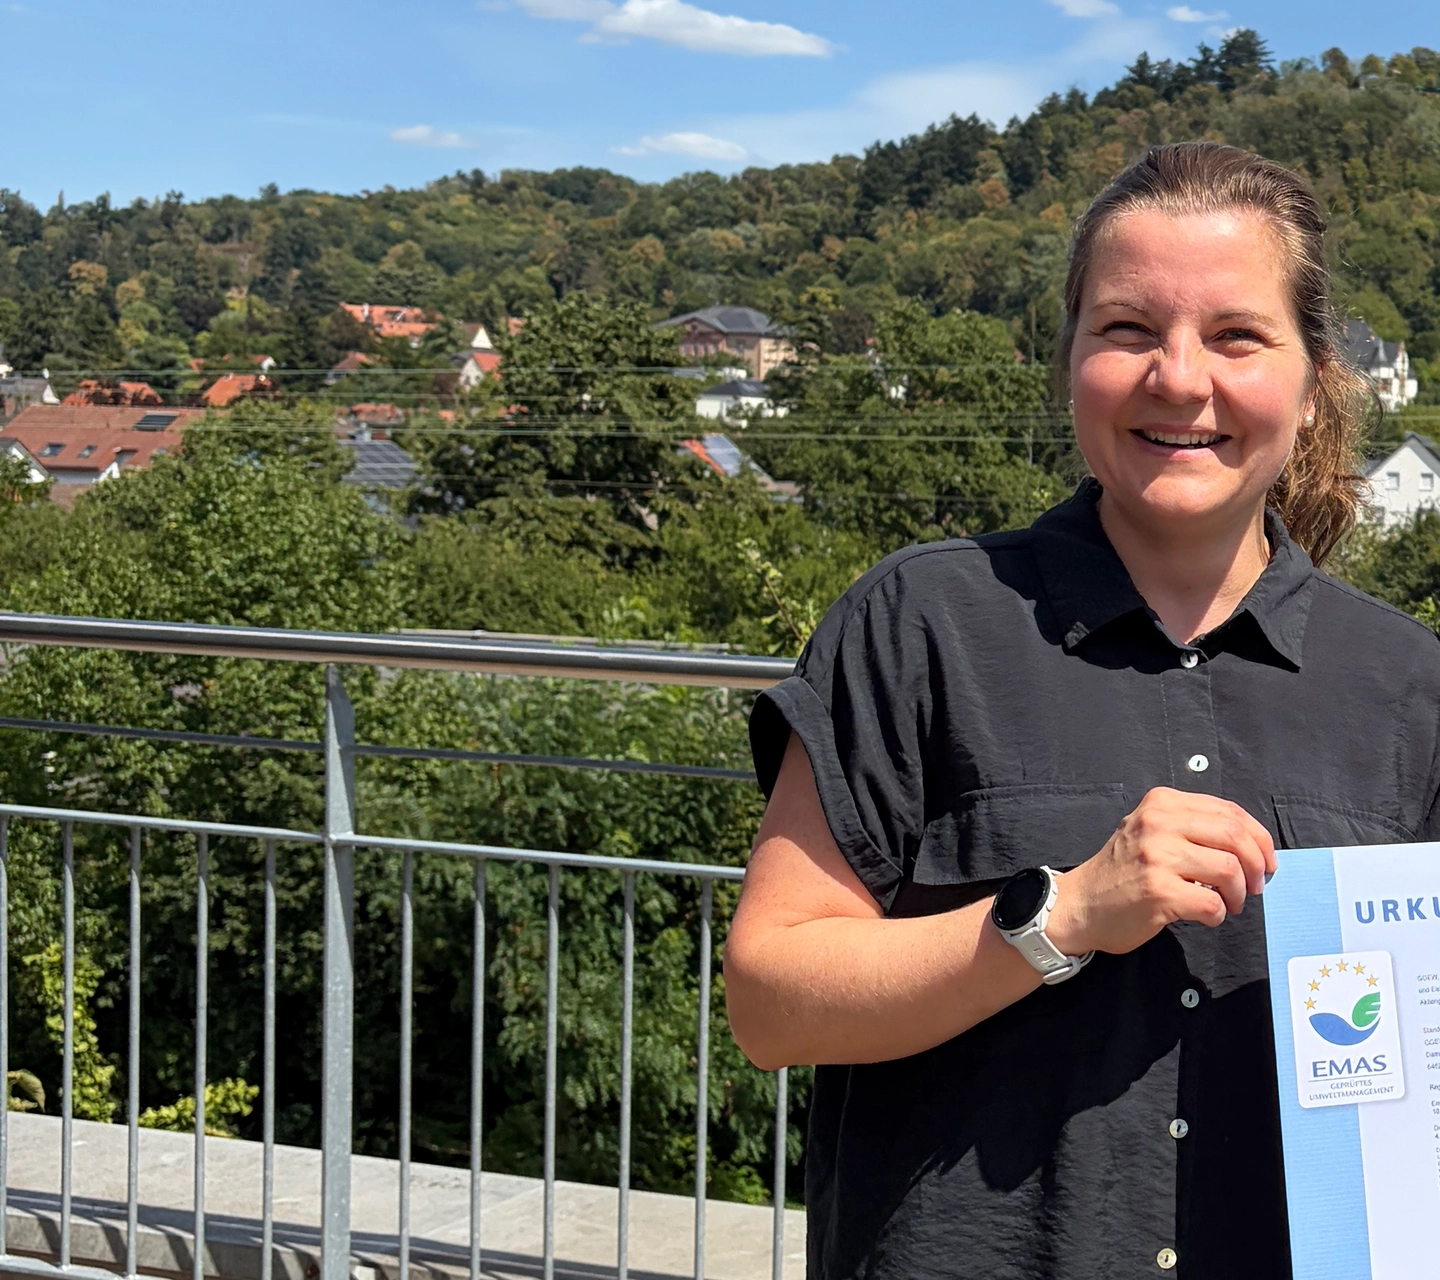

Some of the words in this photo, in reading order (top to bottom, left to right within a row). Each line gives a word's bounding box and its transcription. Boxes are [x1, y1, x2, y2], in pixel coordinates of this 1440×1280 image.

[1312, 1055, 1387, 1077] EMAS
[1330, 1079, 1372, 1090] GEPRÜFTES
[1309, 1086, 1394, 1101] UMWELTMANAGEMENT
